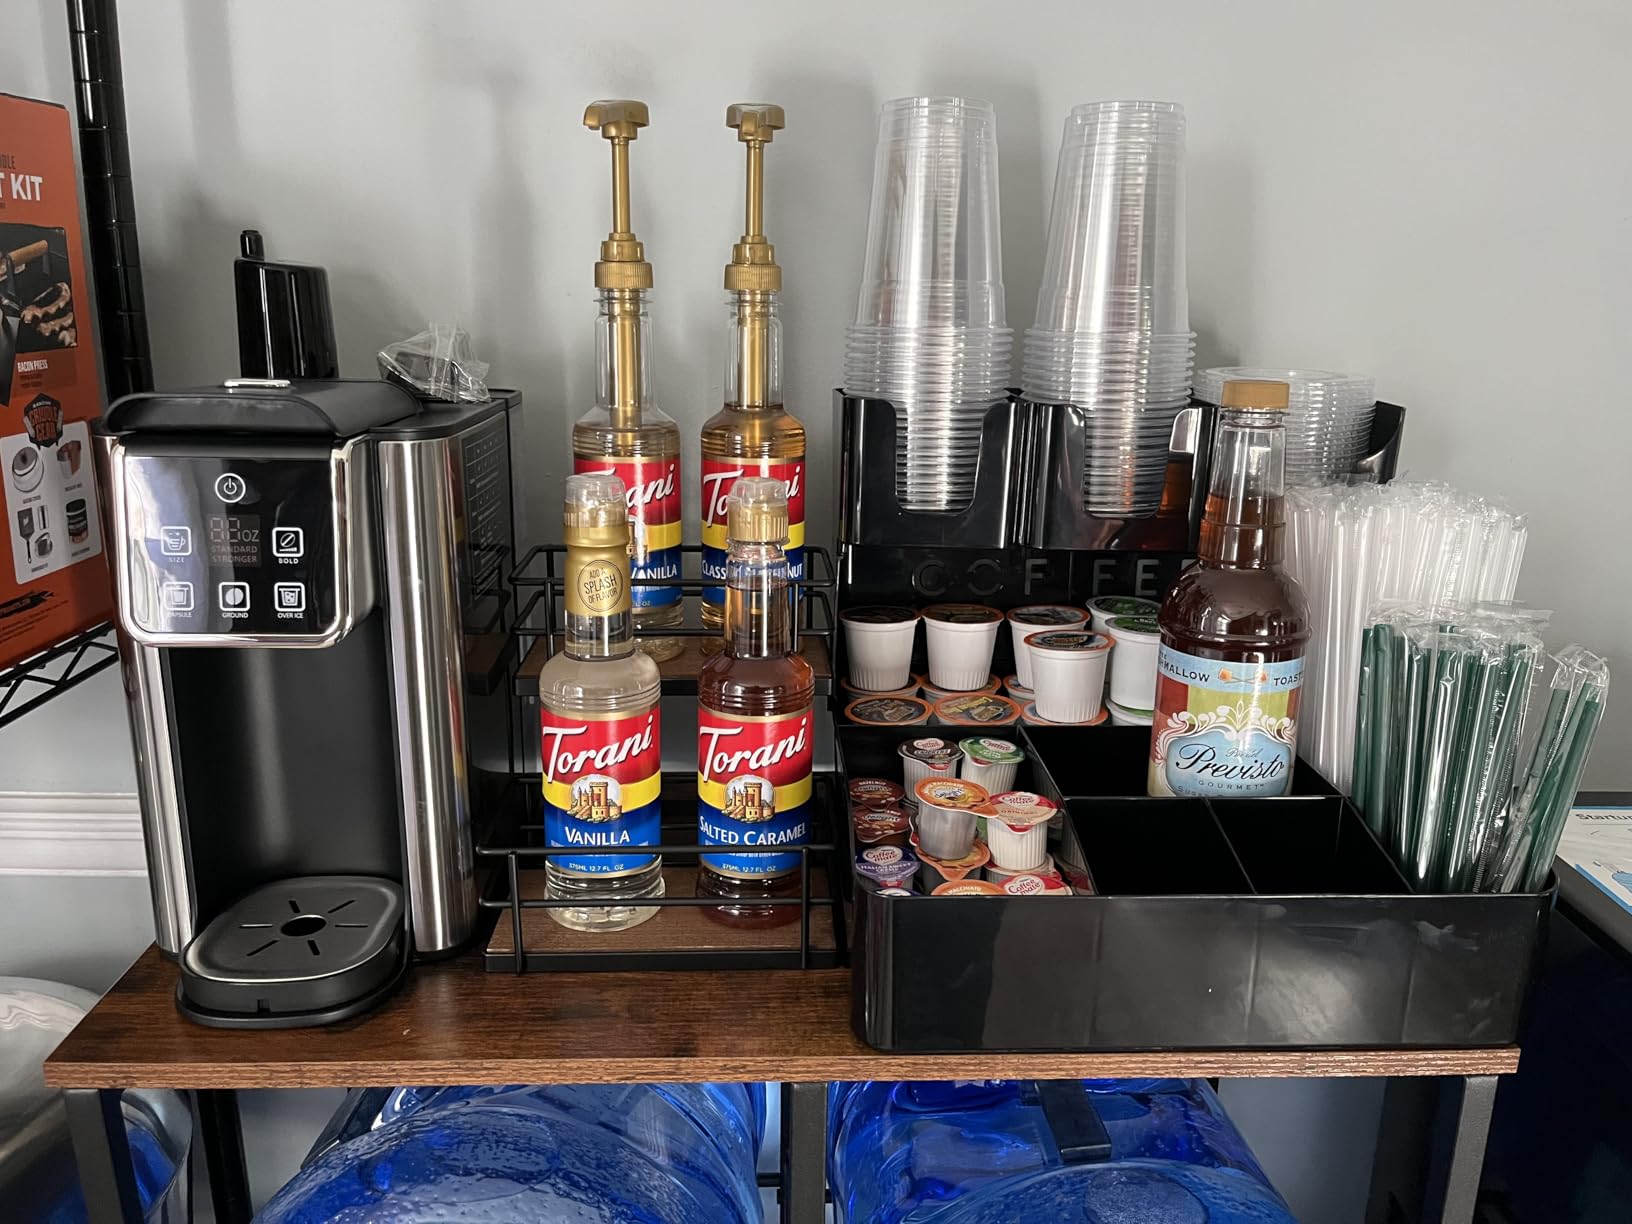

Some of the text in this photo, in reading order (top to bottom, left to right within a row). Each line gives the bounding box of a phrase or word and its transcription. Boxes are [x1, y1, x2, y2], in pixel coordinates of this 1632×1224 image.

[10, 173, 43, 201] KIT
[17, 359, 49, 373] BACON PRESS
[210, 545, 258, 553] STANDARD
[211, 555, 257, 563] STRONGER
[589, 568, 600, 579] ADD
[911, 558, 1160, 597] COFFE
[583, 573, 618, 595] SPLASH
[588, 594, 596, 604] OF
[596, 586, 619, 603] FLAVOR
[542, 714, 654, 784] Torani
[699, 716, 807, 784] Torani
[1175, 743, 1285, 780] Previsto
[1198, 779, 1259, 790] GOURMET
[564, 826, 631, 846] VANILLA
[699, 815, 806, 846] SALTED CARAMEL
[865, 850, 896, 860] Coffee
[874, 854, 899, 863] mate
[568, 862, 588, 872] 375ML
[614, 863, 625, 871] OZ
[742, 865, 754, 873] 12.7
[1008, 879, 1036, 894] Coffee
[1020, 882, 1041, 895] mate
